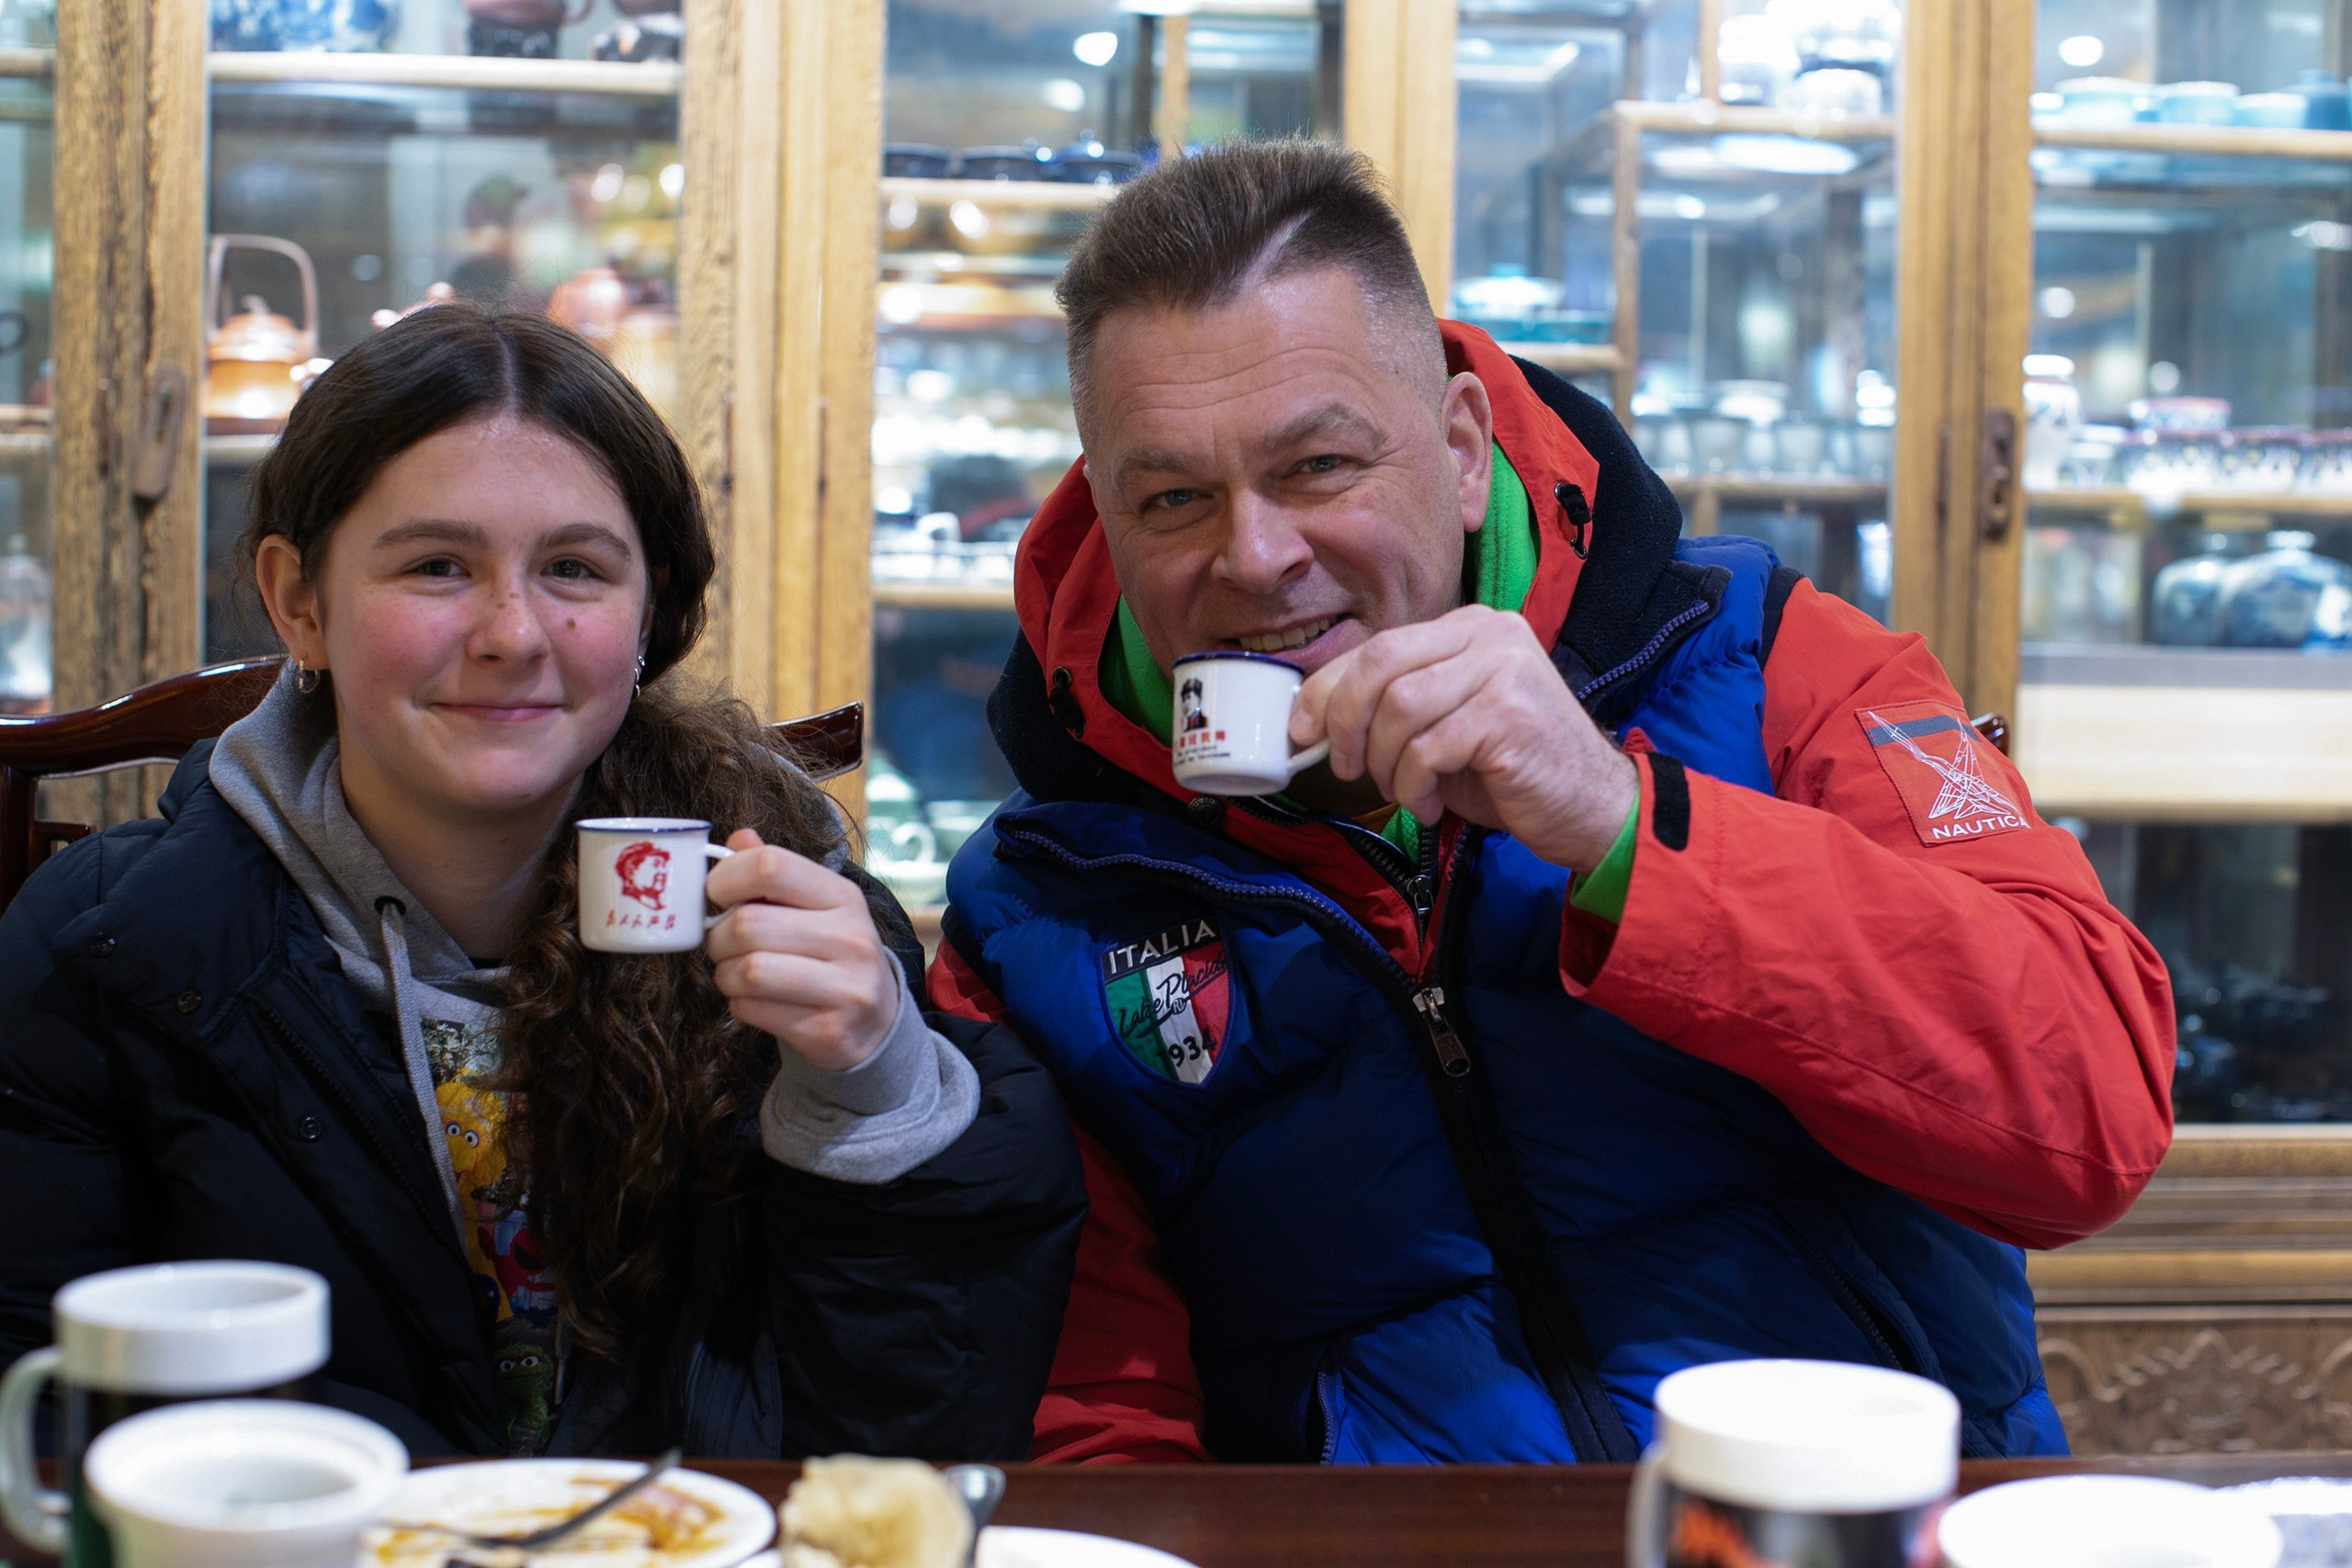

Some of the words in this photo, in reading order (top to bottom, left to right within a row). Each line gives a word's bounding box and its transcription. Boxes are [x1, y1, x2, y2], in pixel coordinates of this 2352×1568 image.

[1932, 815, 2030, 839] NAUTICA
[1109, 919, 1216, 974] ITALIA
[1119, 997, 1165, 1038] Lake
[1156, 1026, 1217, 1067] 934
